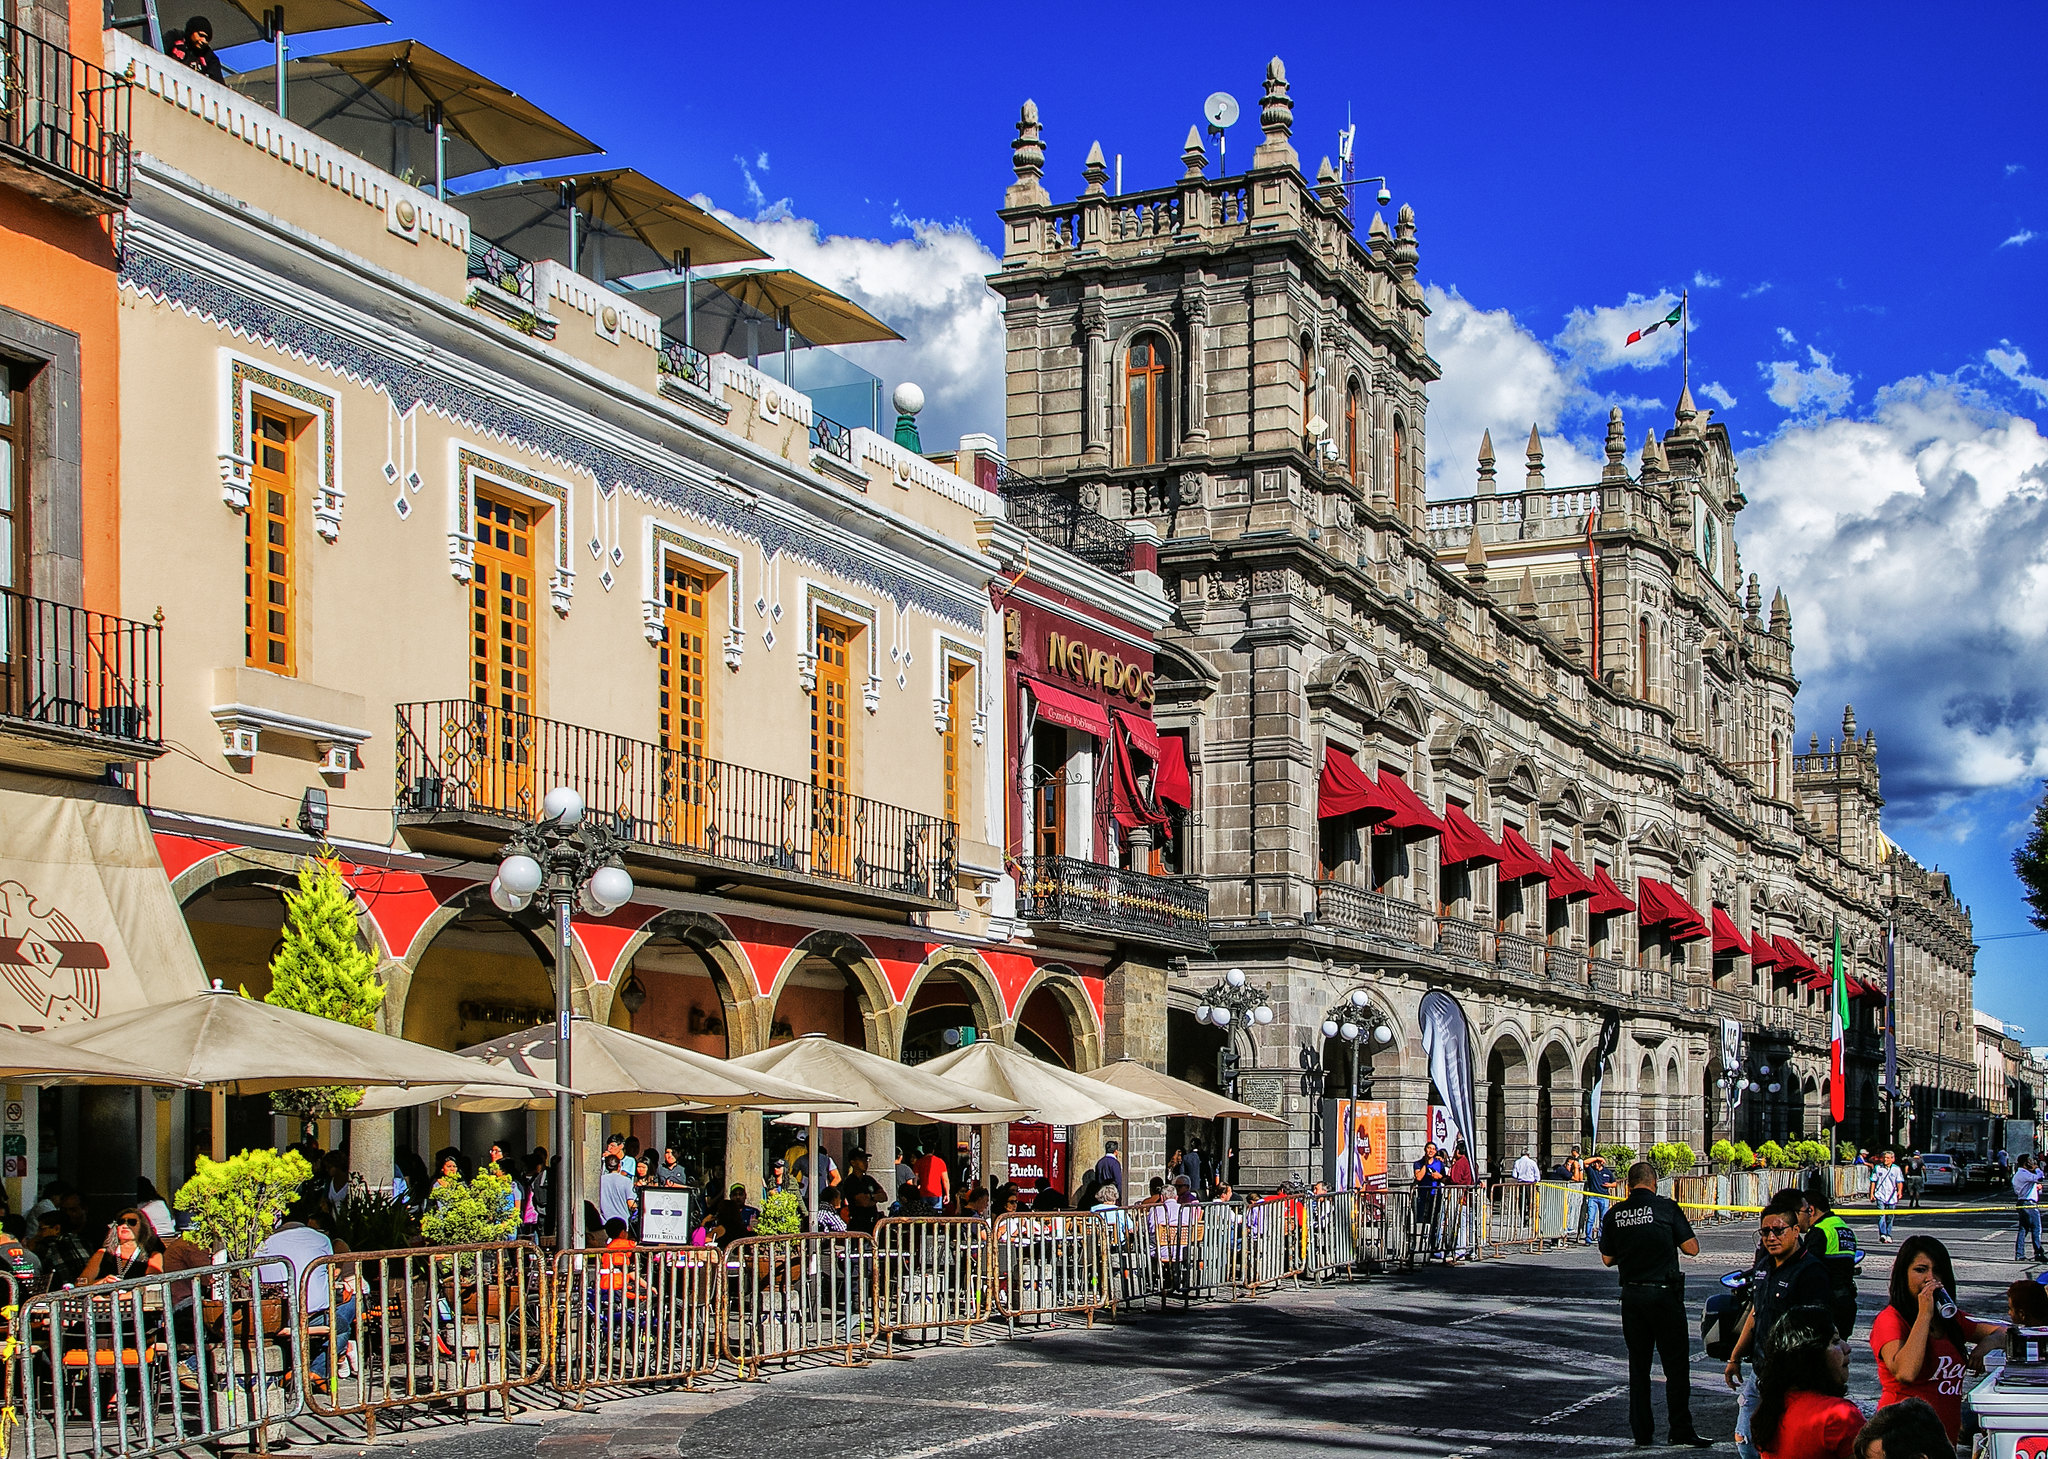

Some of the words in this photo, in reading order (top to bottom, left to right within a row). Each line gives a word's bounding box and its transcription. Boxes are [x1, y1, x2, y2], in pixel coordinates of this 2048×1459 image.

[1049, 631, 1156, 704] NEVADOS
[28, 941, 52, 965] R
[1007, 1143, 1016, 1157] El
[1018, 1143, 1036, 1157] Sol
[1009, 1163, 1044, 1178] Puebla
[1615, 1205, 1653, 1220] POLICÍA
